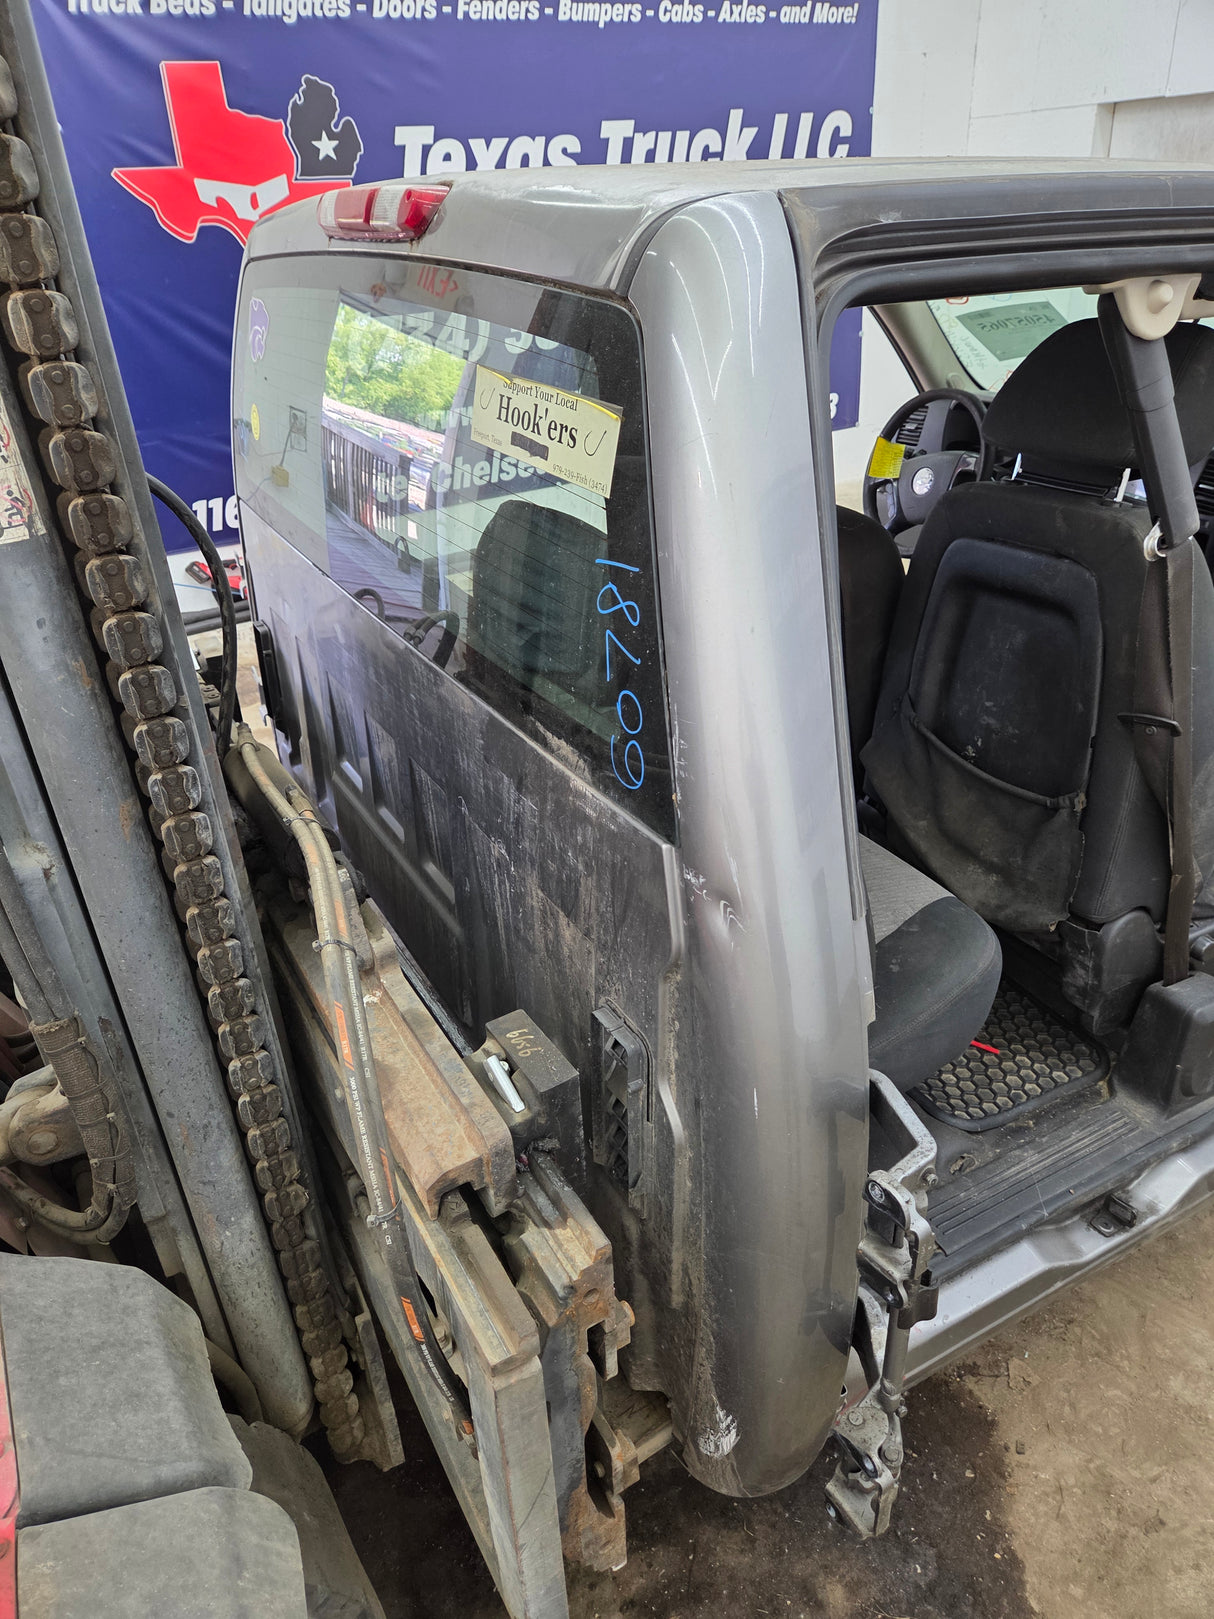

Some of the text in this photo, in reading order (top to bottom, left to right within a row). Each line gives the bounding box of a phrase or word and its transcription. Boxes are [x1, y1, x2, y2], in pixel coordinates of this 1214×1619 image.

[243, 0, 353, 24] Tailgates
[372, 0, 437, 19] Doors
[456, 0, 540, 20] Fenders
[557, 0, 642, 28] Bumpers
[658, 1, 704, 23] Cabs
[717, 1, 767, 23] Axles
[780, 2, 811, 24] and
[812, 3, 860, 24] More!
[394, 125, 582, 178] Texas
[600, 108, 759, 165] Truck
[503, 381, 579, 411] Support Your Local
[496, 393, 579, 449] Hook'ers
[431, 451, 546, 493] Chelse
[595, 558, 645, 790] 60781
